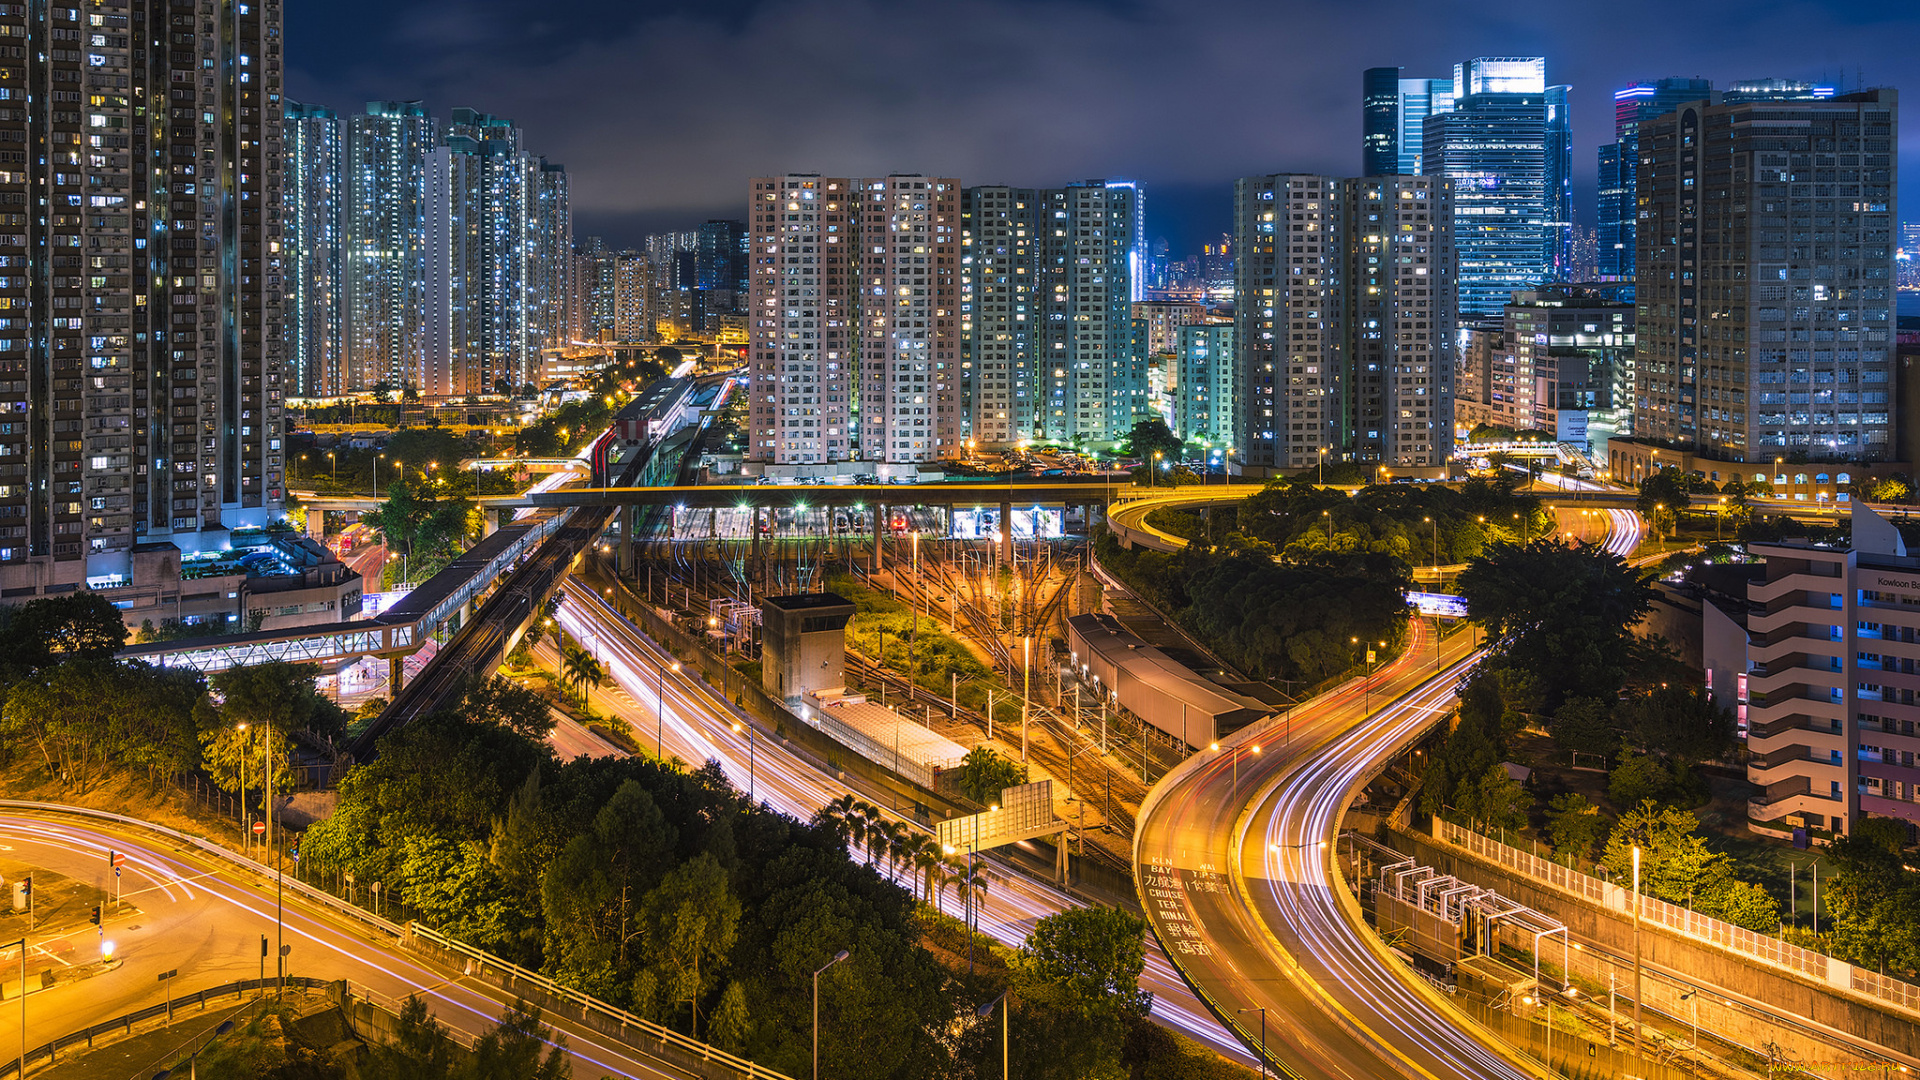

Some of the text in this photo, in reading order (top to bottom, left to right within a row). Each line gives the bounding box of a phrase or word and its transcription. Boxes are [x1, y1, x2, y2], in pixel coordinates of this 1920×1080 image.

[1877, 577, 1910, 588] Kowloon
[1152, 856, 1173, 866] KLN
[1151, 865, 1171, 874] BAY
[1149, 889, 1184, 900] CRUISE
[1159, 910, 1190, 921] MINAL
